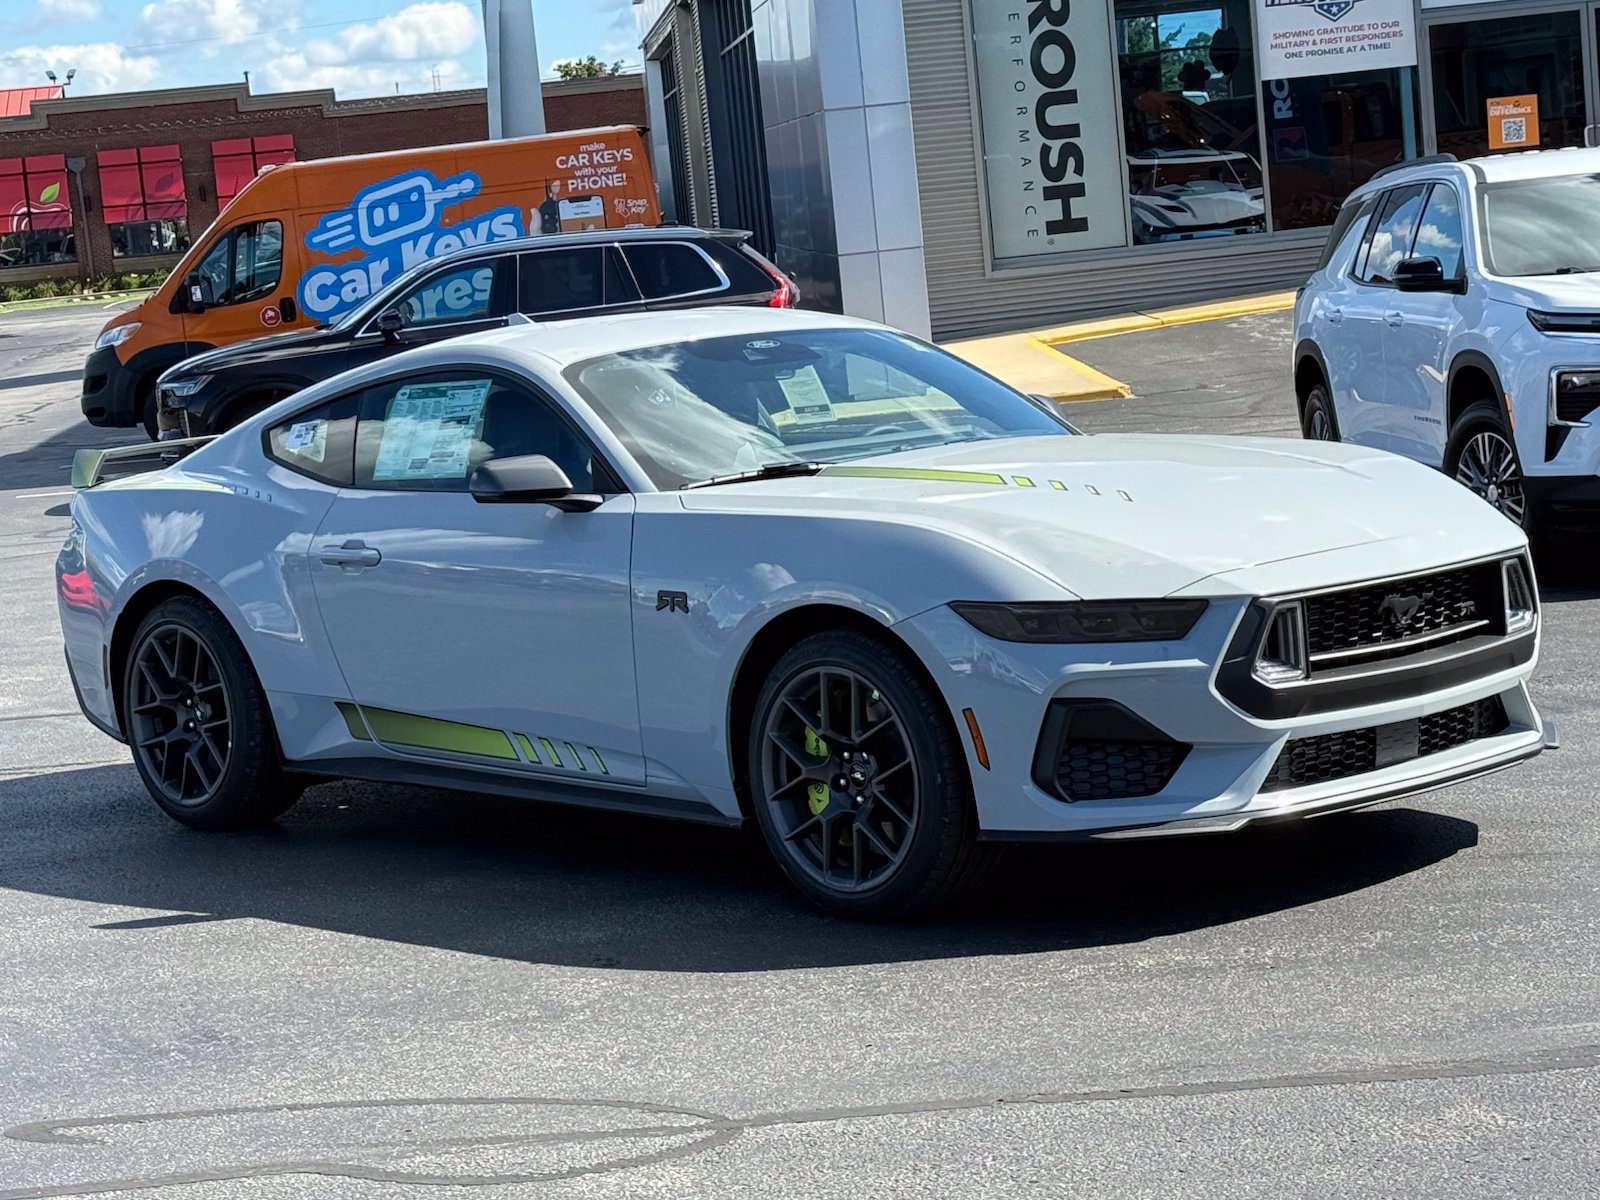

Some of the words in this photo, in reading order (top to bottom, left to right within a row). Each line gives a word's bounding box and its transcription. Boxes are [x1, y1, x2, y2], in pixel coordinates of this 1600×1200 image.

[1270, 40, 1310, 50] MILITARY
[1320, 37, 1343, 45] FIRST
[1345, 30, 1404, 43] RESPONDERS
[1273, 29, 1315, 40] SHOWING
[1317, 23, 1365, 36] GRATITUDE
[1367, 23, 1378, 31] TO
[1381, 21, 1400, 29] OUR
[1284, 51, 1304, 59] ONE
[1306, 47, 1345, 57] PROMISE
[1346, 45, 1357, 53] AT
[1358, 44, 1367, 52] A
[1367, 42, 1391, 51] TIME!
[1026, 0, 1089, 236] ROUSH
[580, 142, 606, 152] make
[556, 153, 590, 169] CAR
[593, 148, 633, 165] KEYS
[574, 166, 595, 177] with
[597, 165, 618, 175] your
[567, 173, 627, 192] PHONE!
[304, 256, 389, 312] Car
